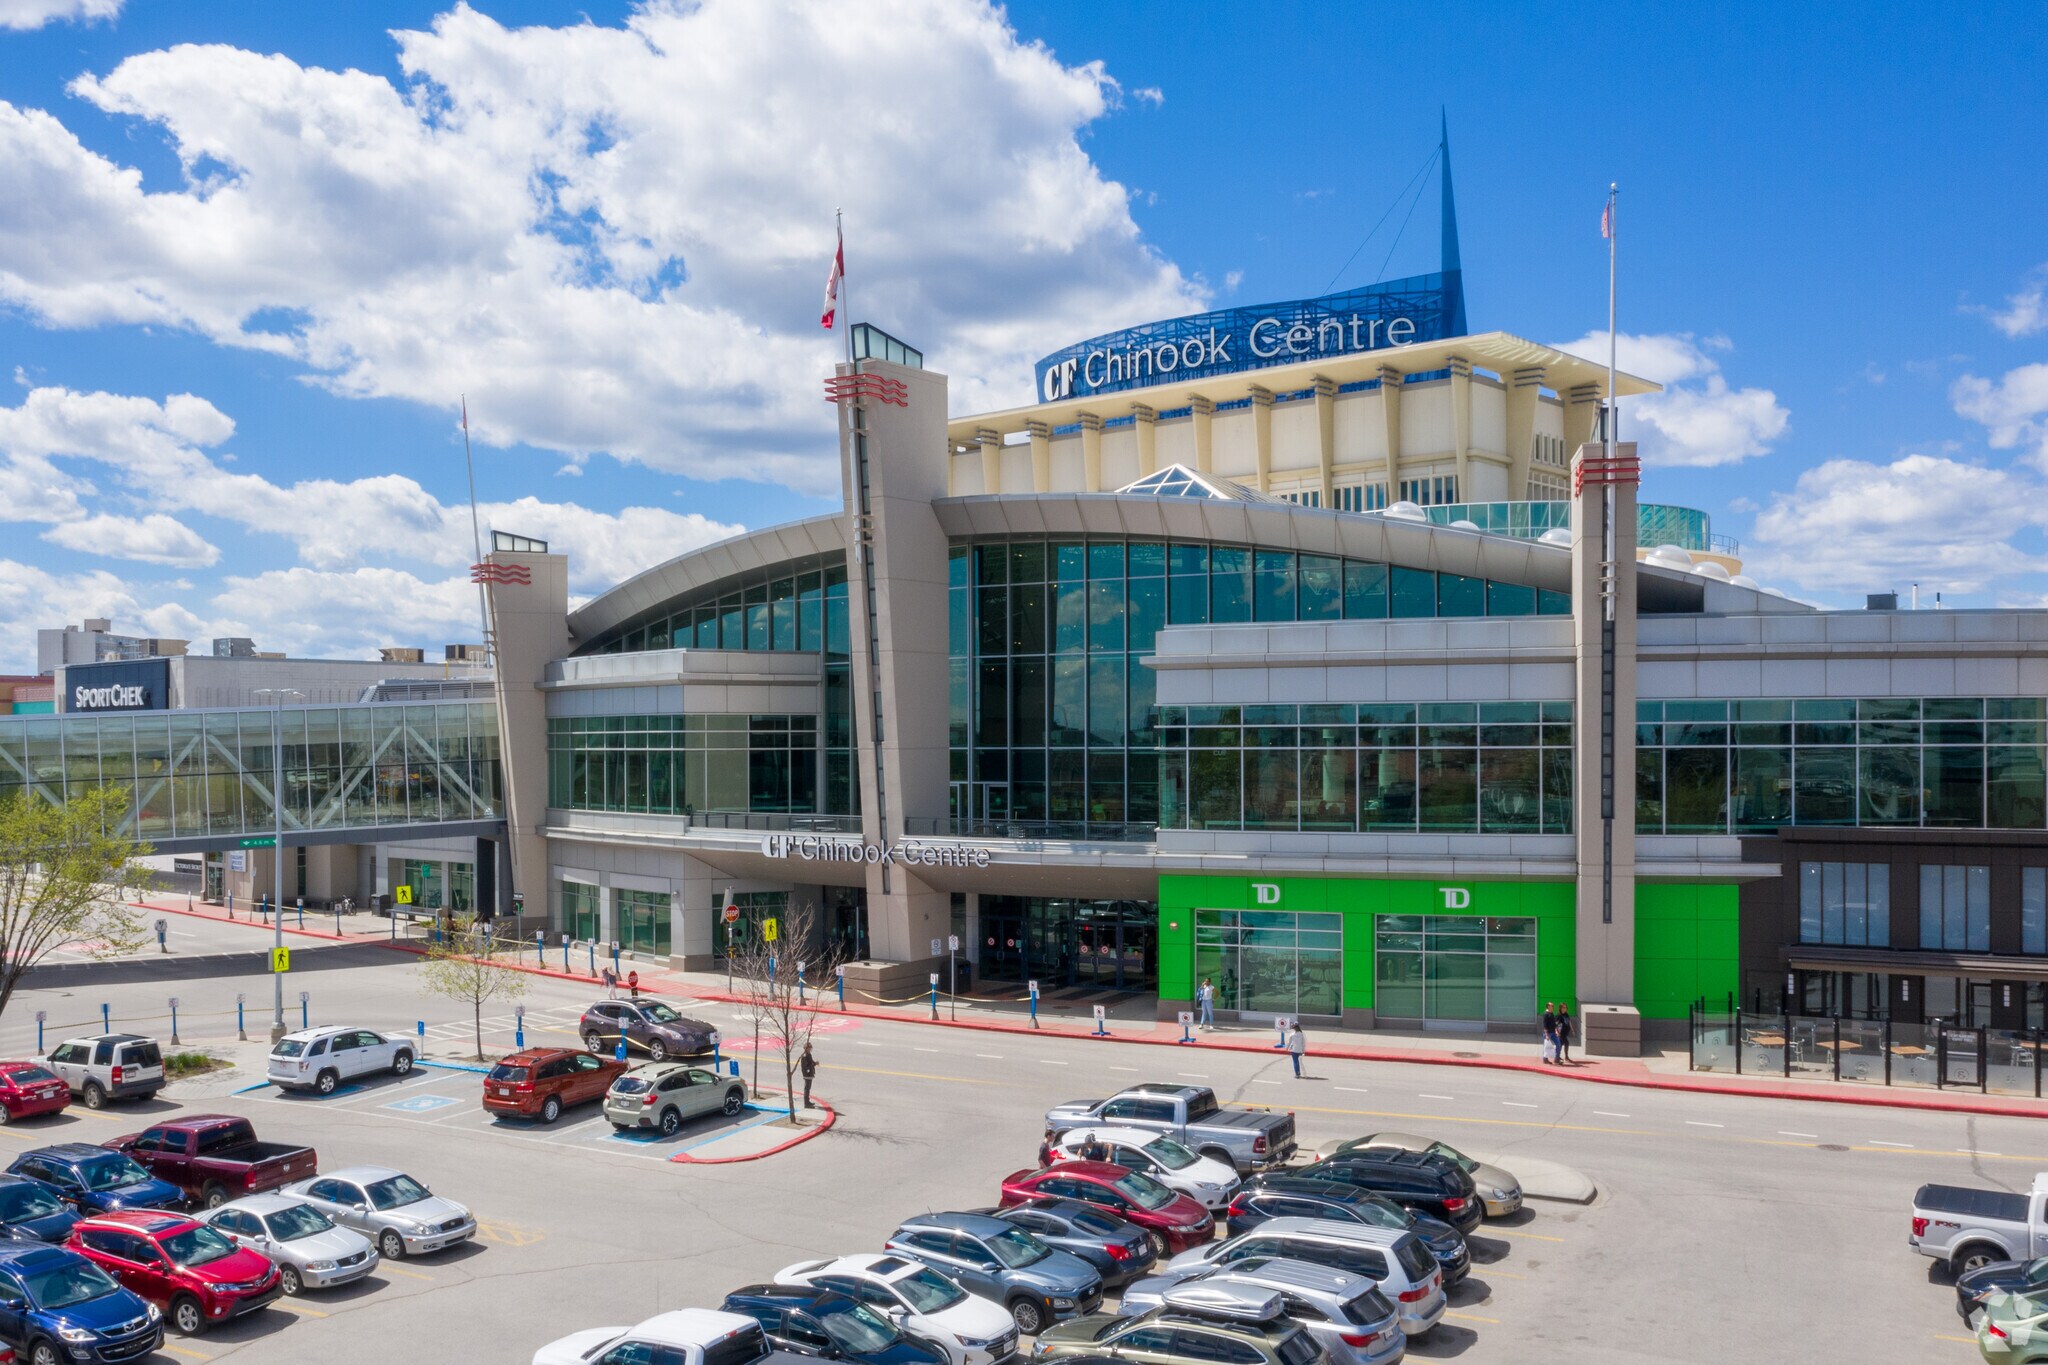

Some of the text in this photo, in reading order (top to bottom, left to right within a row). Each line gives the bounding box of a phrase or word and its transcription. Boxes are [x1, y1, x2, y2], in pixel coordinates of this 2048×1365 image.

[1044, 313, 1416, 401] CF Chinook Centre
[761, 835, 990, 868] CF Chinook Centre
[1251, 883, 1281, 904] TD
[1438, 888, 1470, 909] TD
